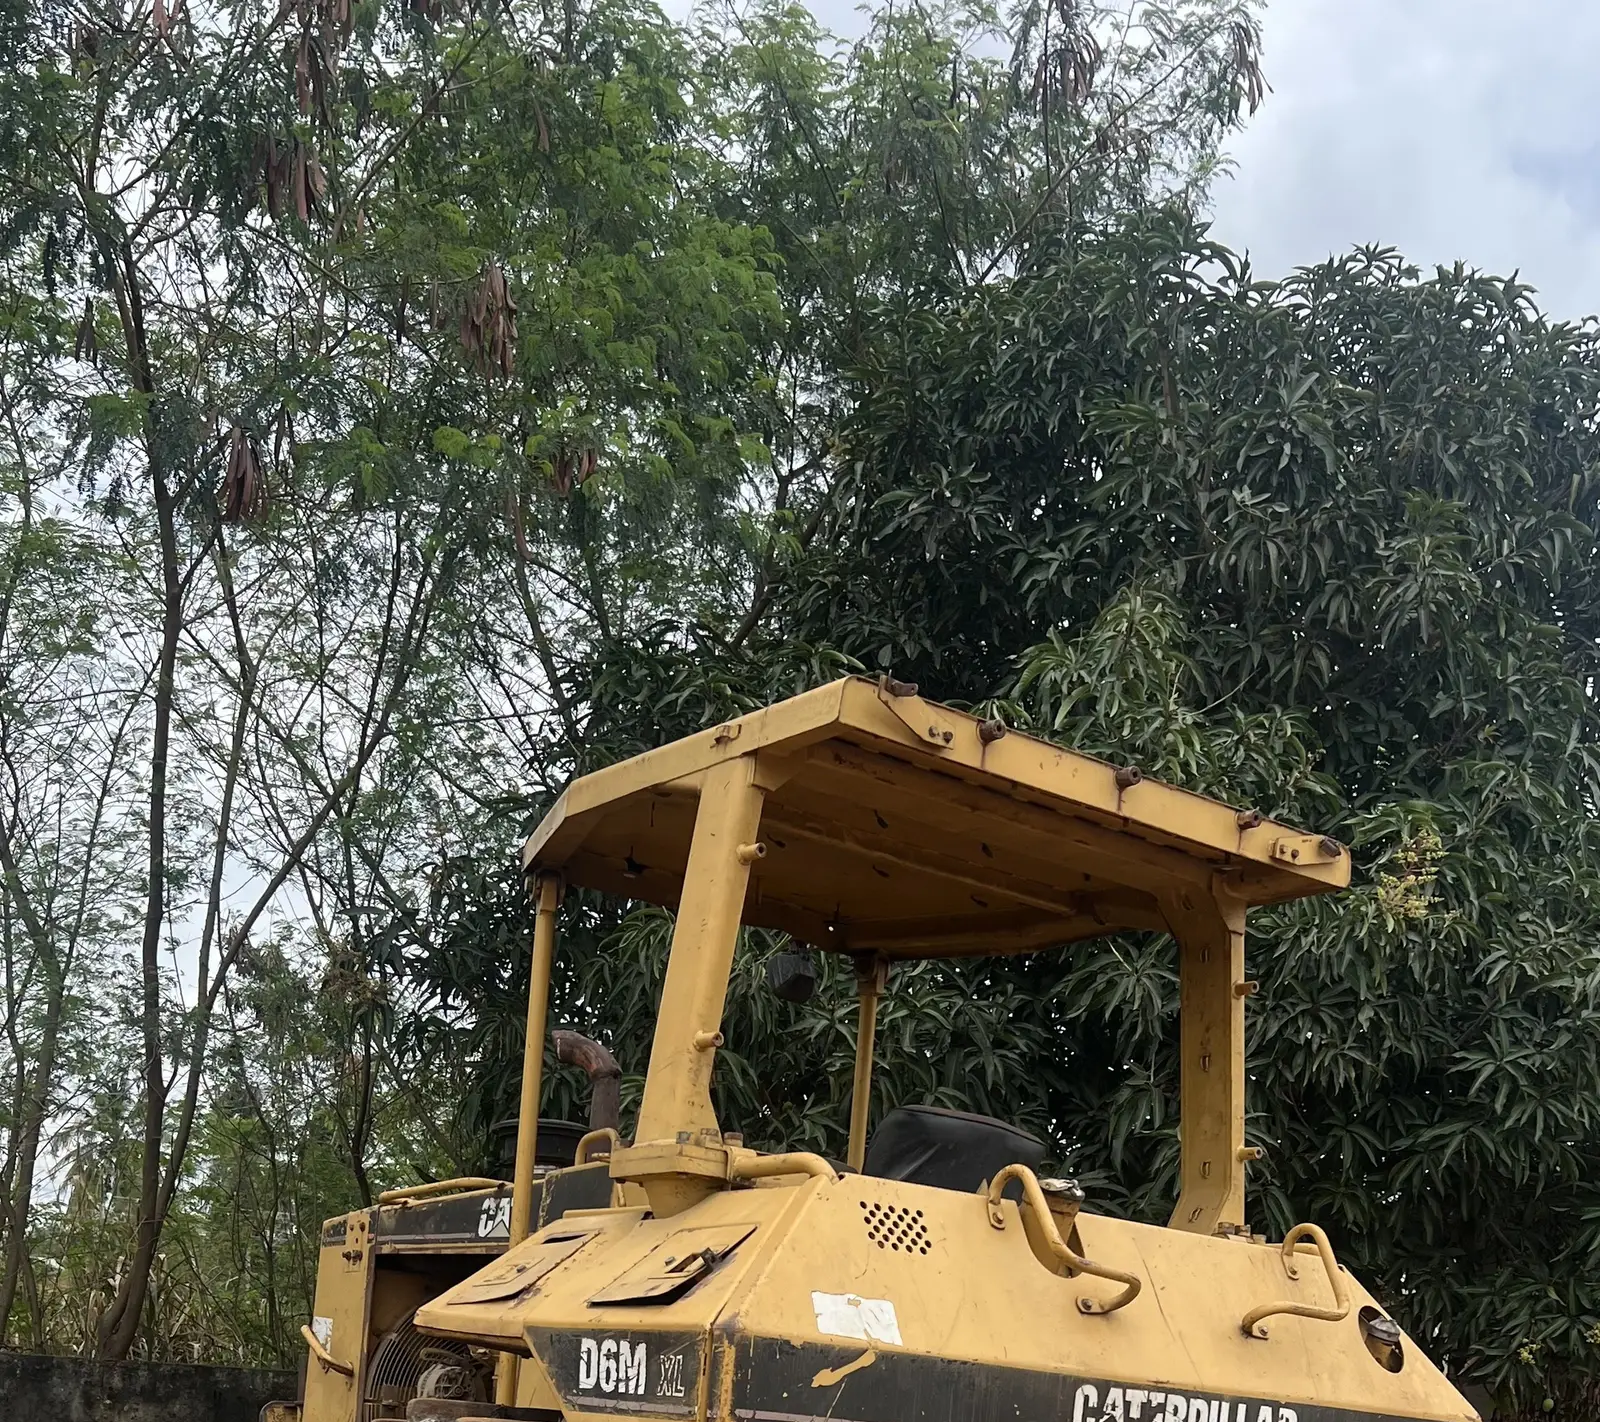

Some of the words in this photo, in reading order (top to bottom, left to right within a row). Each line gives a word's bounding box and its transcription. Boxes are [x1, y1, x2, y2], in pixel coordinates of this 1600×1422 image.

[478, 1197, 514, 1238] CA
[579, 1337, 647, 1395] D6M
[656, 1354, 685, 1397] XL
